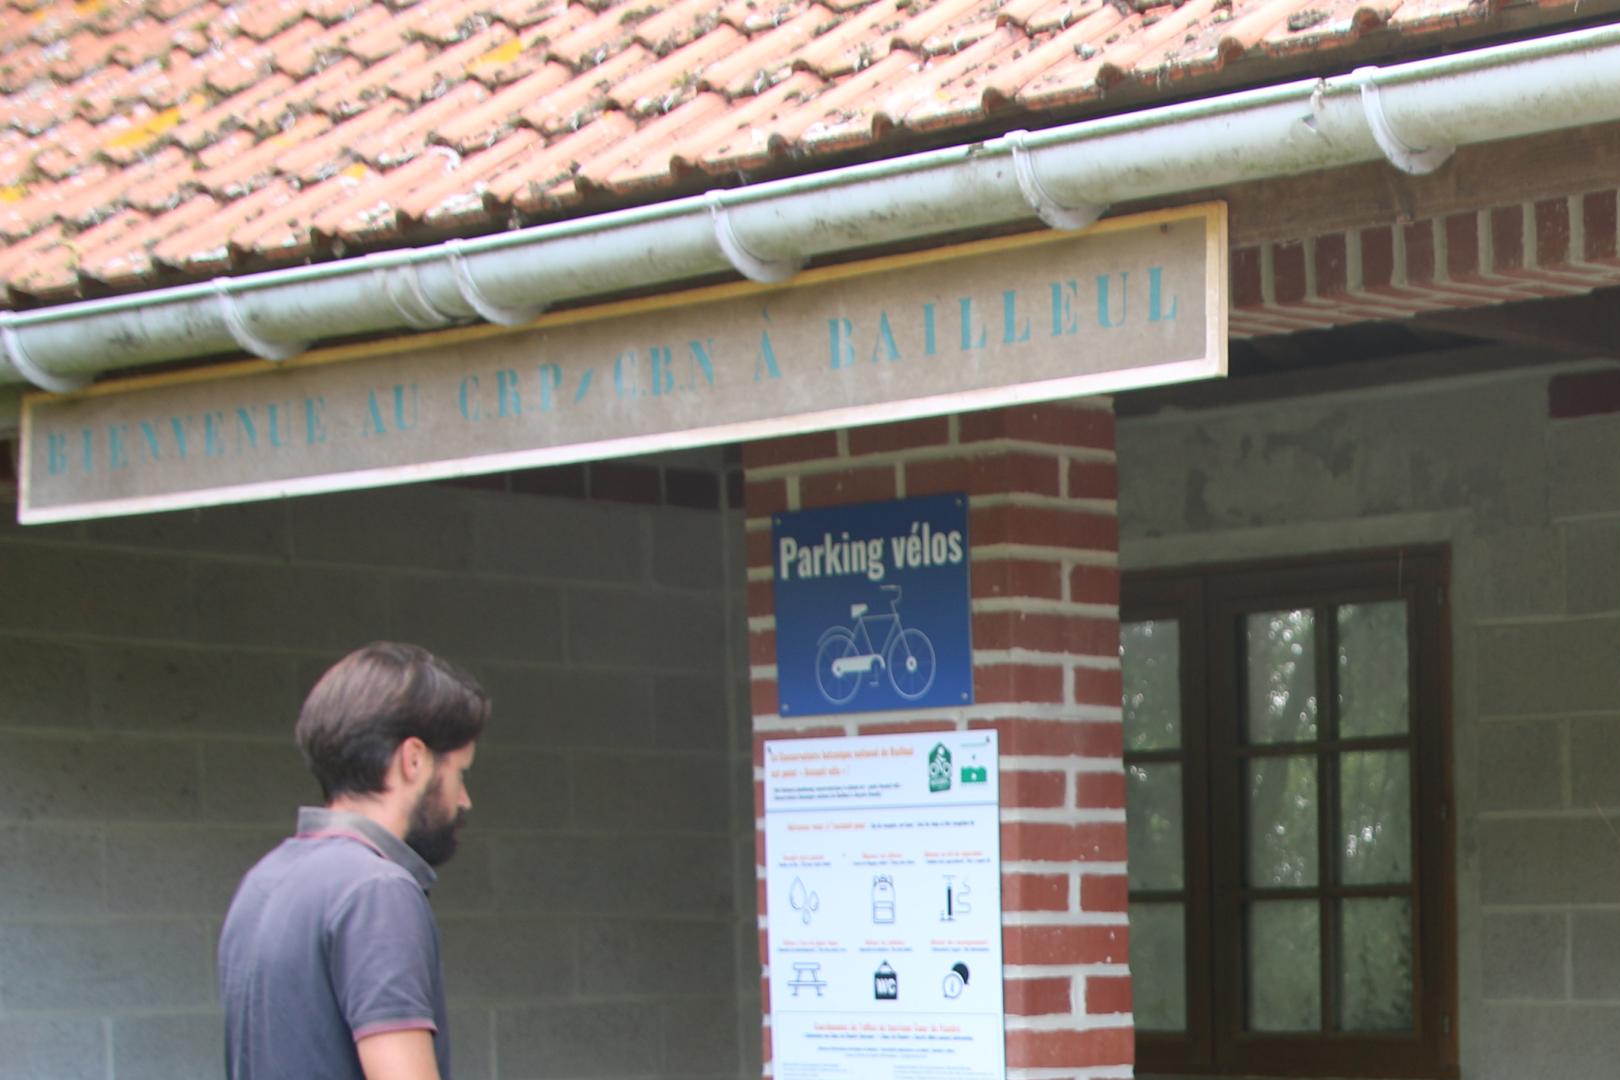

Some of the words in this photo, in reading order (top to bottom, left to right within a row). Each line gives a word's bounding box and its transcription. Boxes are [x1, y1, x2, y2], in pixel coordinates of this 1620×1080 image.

[46, 395, 328, 476] BIENVENUE
[361, 383, 418, 438] AU
[827, 266, 1178, 370] BAILLEUL
[779, 531, 885, 581] Parking
[891, 521, 964, 569] vélos
